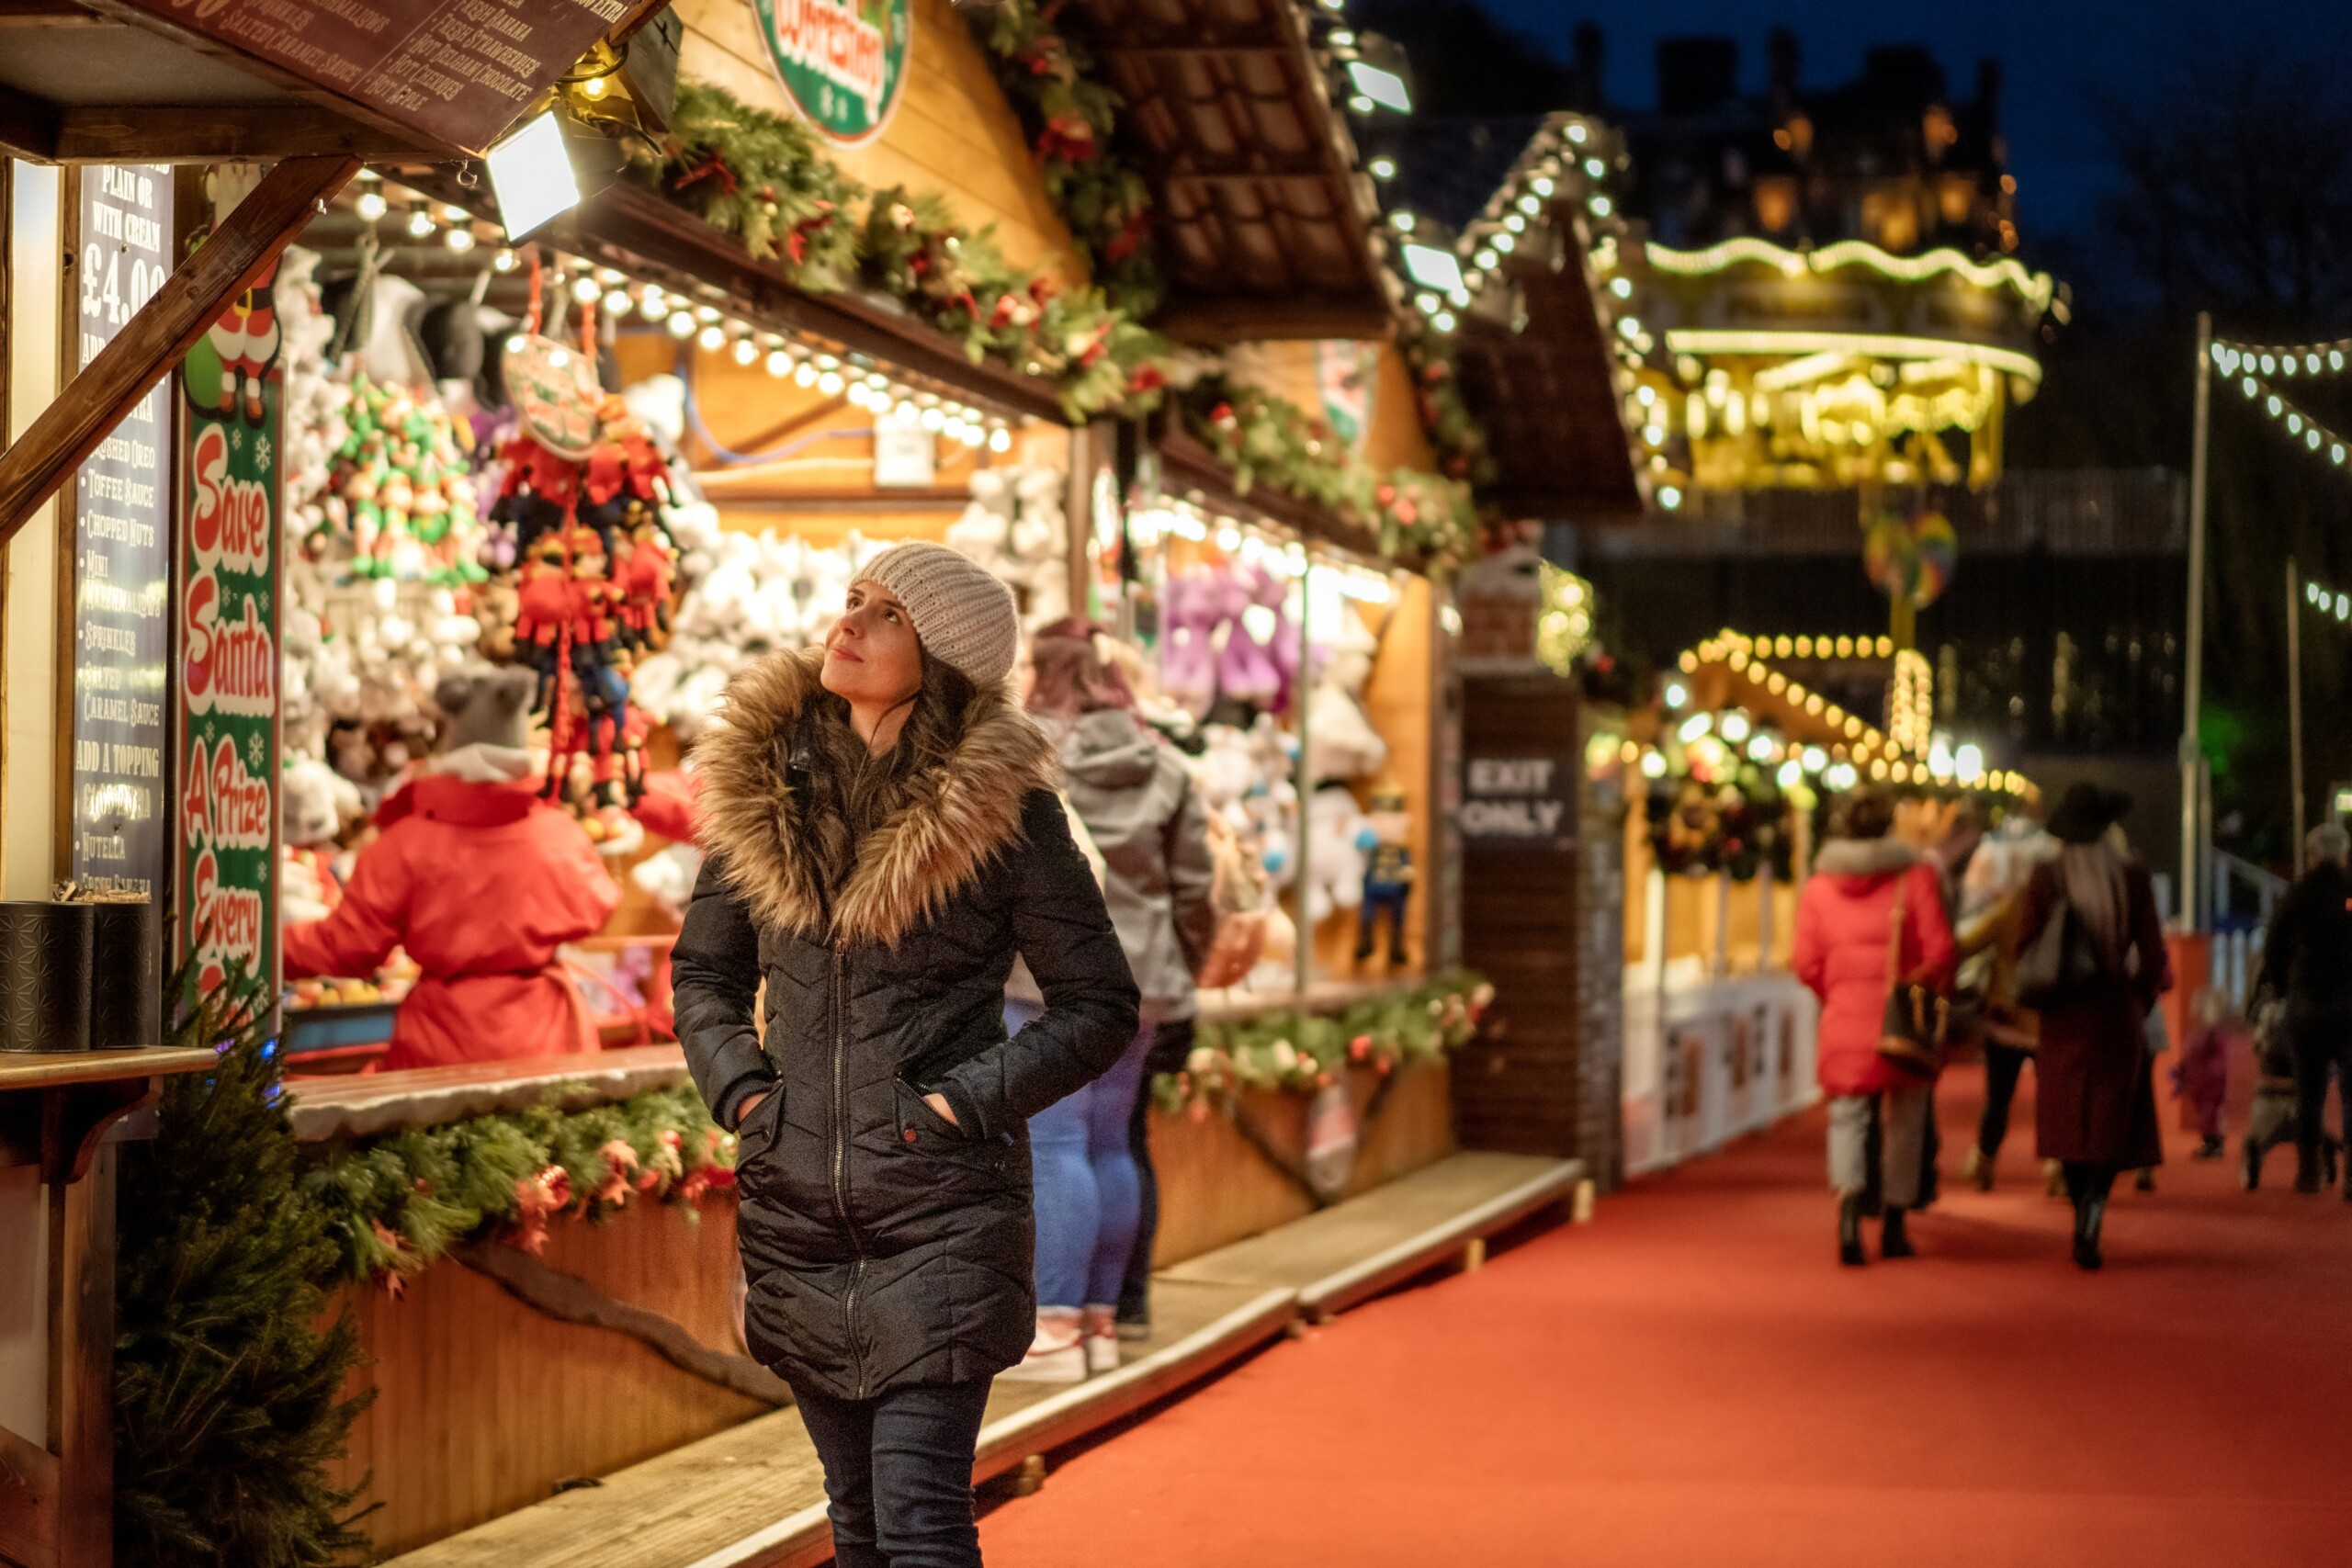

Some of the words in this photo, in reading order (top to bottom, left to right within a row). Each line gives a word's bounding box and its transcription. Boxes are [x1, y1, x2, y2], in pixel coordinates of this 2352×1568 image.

[483, 8, 533, 41] BANANA
[220, 8, 275, 42] SALTED
[265, 29, 324, 68] CARAMEL
[316, 53, 363, 83] SAUCE
[431, 13, 474, 41] FRESH
[462, 29, 541, 78] STRAWBERRIES
[364, 74, 397, 97] HOT
[386, 53, 420, 76] HOT
[408, 63, 464, 101] CHERRIES
[408, 33, 442, 56] HOT
[429, 43, 482, 77] BELGIAN
[470, 63, 533, 101] CHOCOLATE
[102, 165, 136, 203] PLAIN
[138, 176, 153, 209] OR
[93, 200, 123, 241] WITH
[125, 213, 161, 253] CREAM
[131, 439, 155, 468] OREO
[88, 468, 123, 502] TOFFEE
[125, 477, 154, 508] SAUCE
[194, 426, 268, 570] Save
[86, 509, 128, 542] CHOPPED
[130, 518, 154, 547] NUTS
[86, 549, 108, 579] MINI
[85, 620, 136, 658] SPRINKLES
[187, 570, 273, 708] Santa
[85, 660, 121, 691] SALTED
[85, 693, 129, 723] CARAMEL
[130, 698, 160, 728] SAUCE
[76, 739, 100, 772] ADD
[103, 743, 110, 773] A
[113, 744, 160, 778] TOPPING
[1468, 759, 1555, 795] EXIT
[186, 738, 212, 843] A
[212, 737, 269, 844] Prize
[1461, 800, 1564, 837] ONLY
[83, 832, 126, 862] NUTELLA
[194, 851, 261, 974] Every
